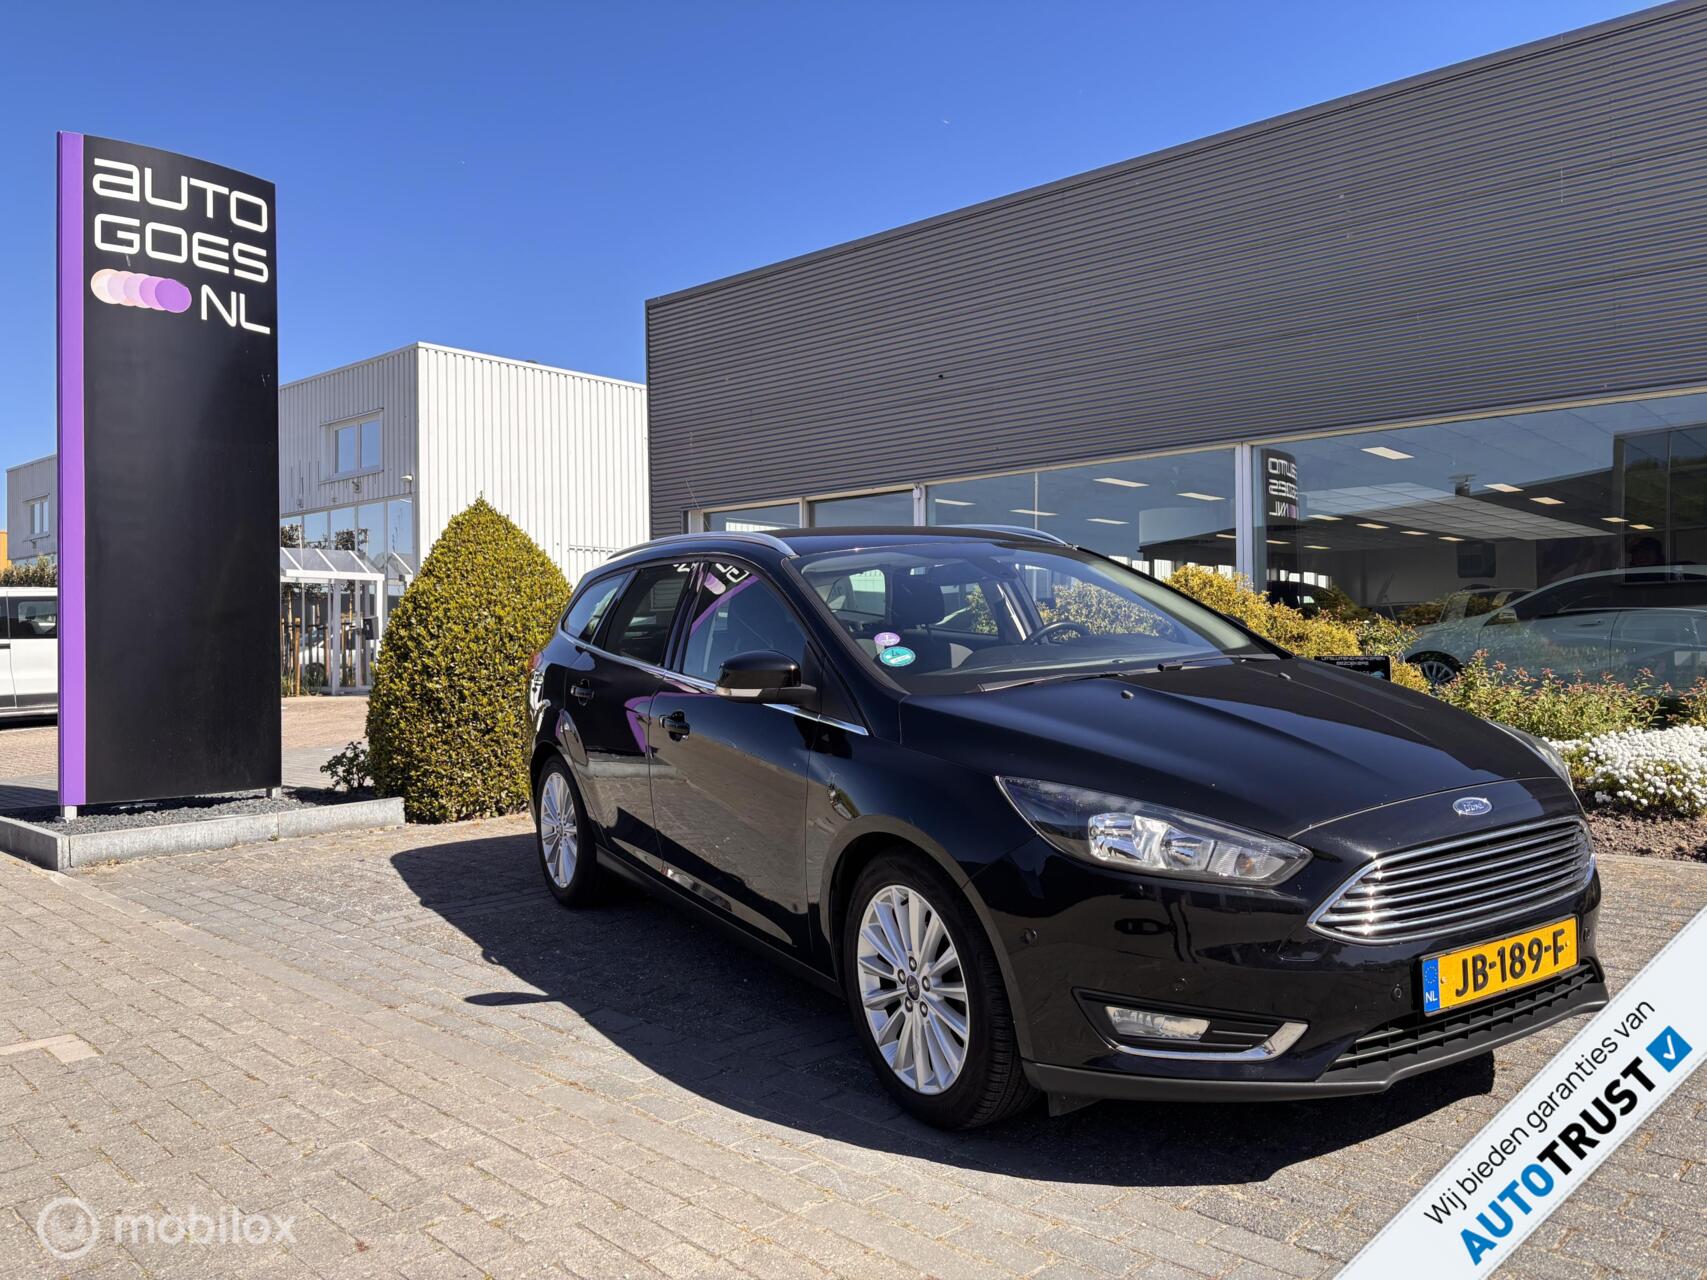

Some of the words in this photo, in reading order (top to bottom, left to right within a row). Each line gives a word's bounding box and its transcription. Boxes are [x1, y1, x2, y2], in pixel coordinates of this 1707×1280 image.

[94, 213, 269, 283] GOES
[201, 284, 271, 335] NL
[1455, 928, 1566, 997] JB-189-F
[1425, 991, 1438, 1003] NL
